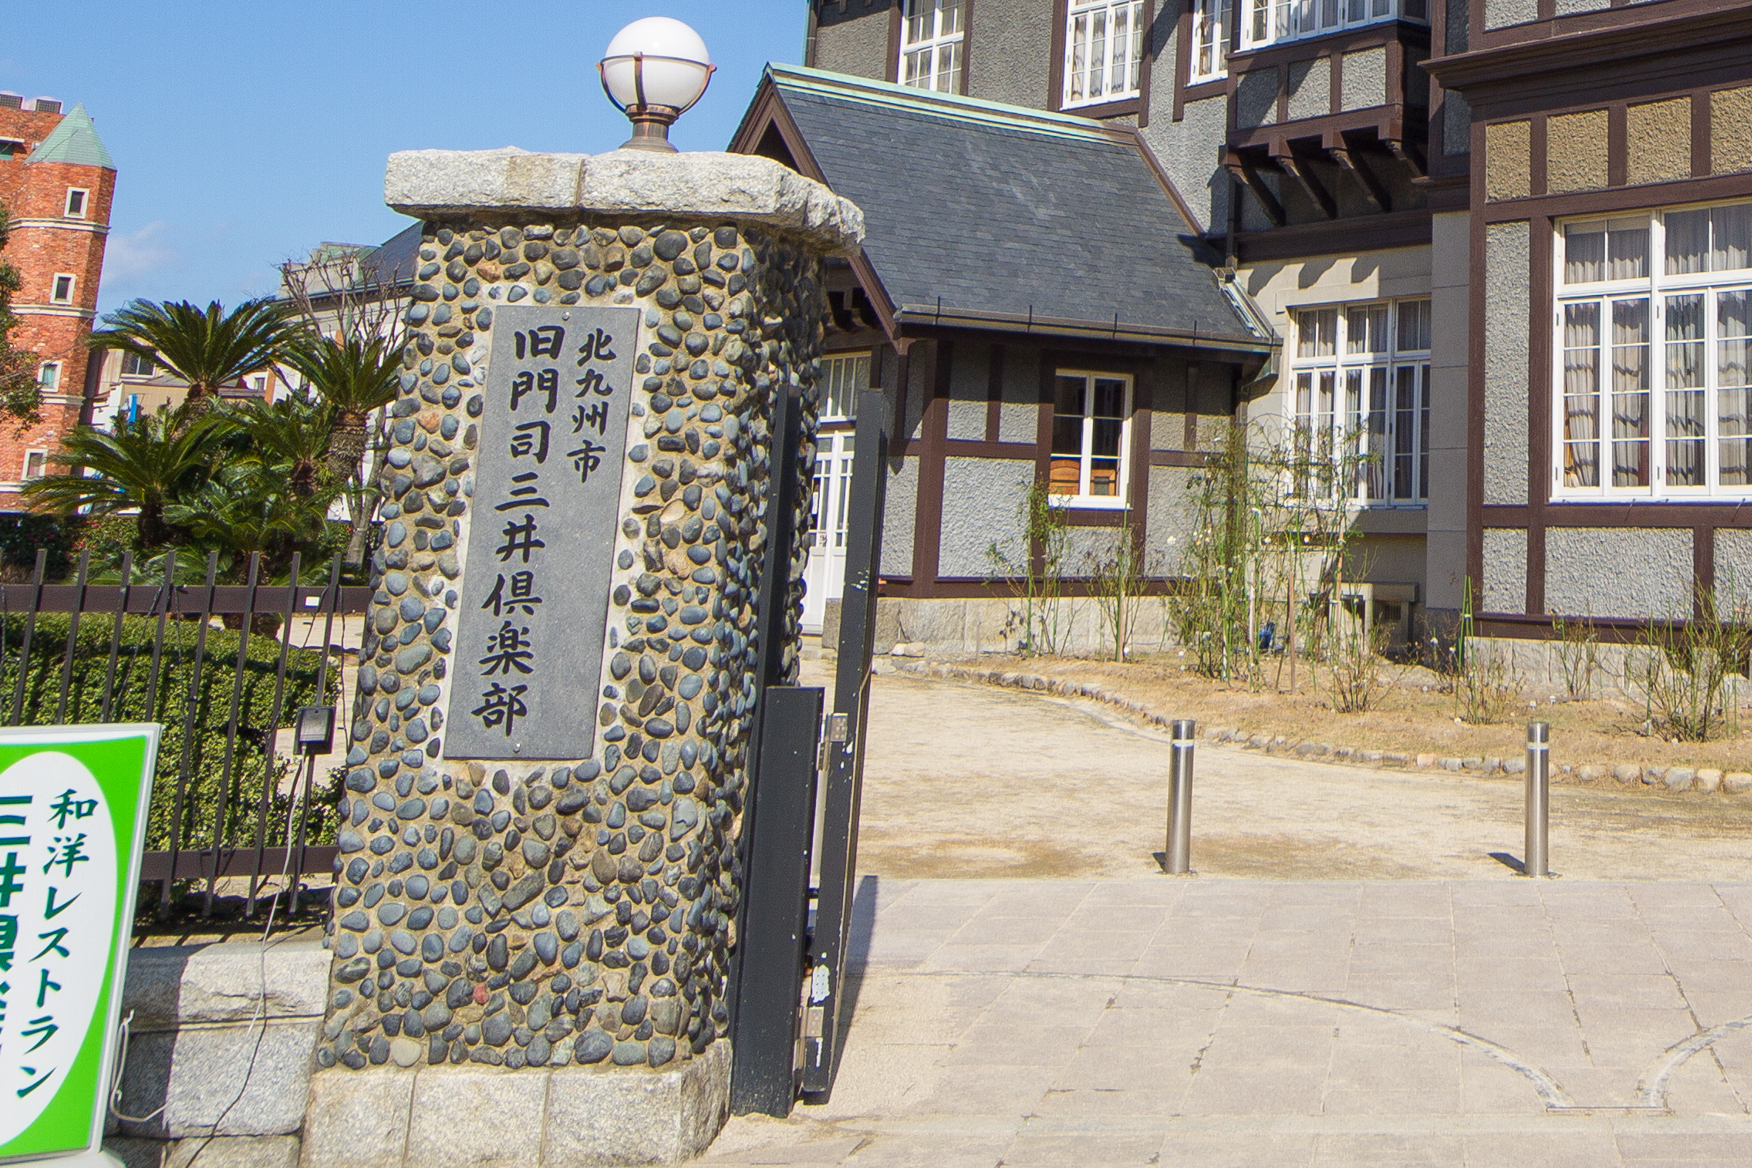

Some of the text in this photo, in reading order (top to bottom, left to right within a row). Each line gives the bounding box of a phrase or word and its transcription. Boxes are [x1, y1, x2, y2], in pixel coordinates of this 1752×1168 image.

[471, 325, 565, 736] 旧門司三井倶楽部
[567, 327, 616, 484] 北九州市
[17, 788, 99, 1099] 和洋レストラン
